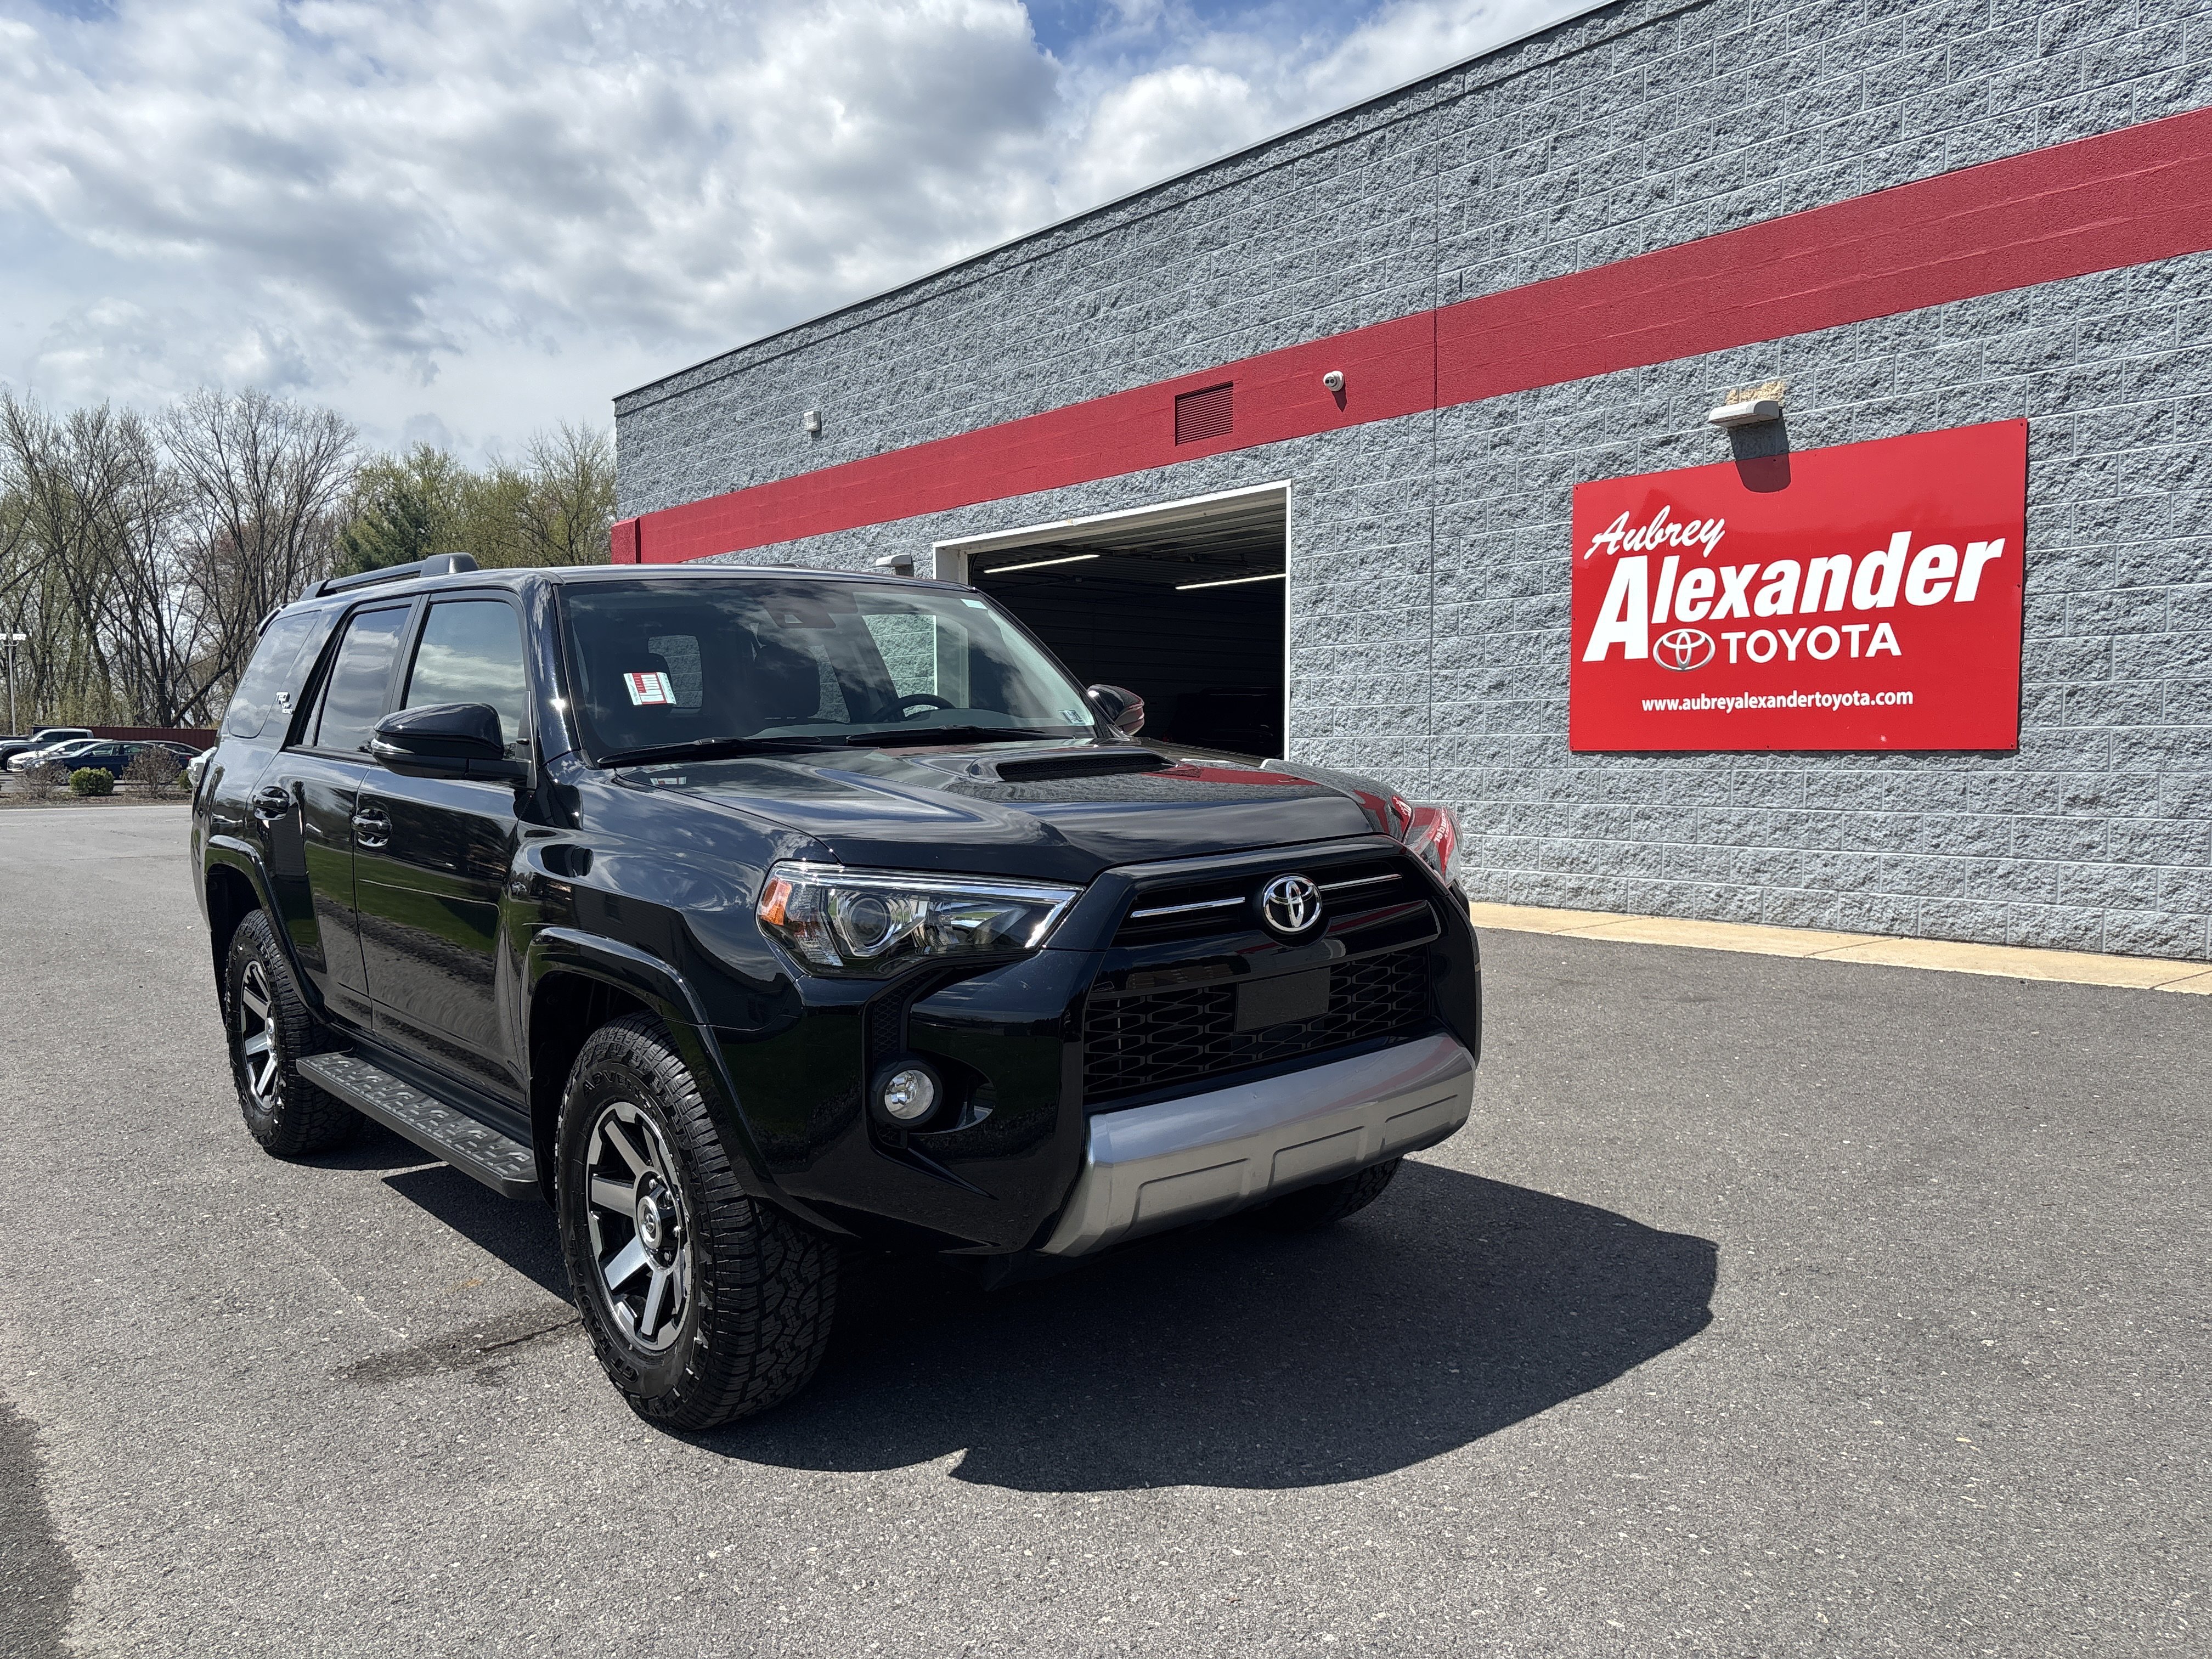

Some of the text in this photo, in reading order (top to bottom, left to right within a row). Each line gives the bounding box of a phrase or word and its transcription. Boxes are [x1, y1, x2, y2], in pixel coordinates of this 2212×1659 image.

[1584, 505, 1725, 560] Aubrey
[1582, 531, 2006, 662] Alexander
[1722, 623, 1902, 664] TOYOTA
[1641, 690, 1914, 713] www.aubreyalexandertoyota.com
